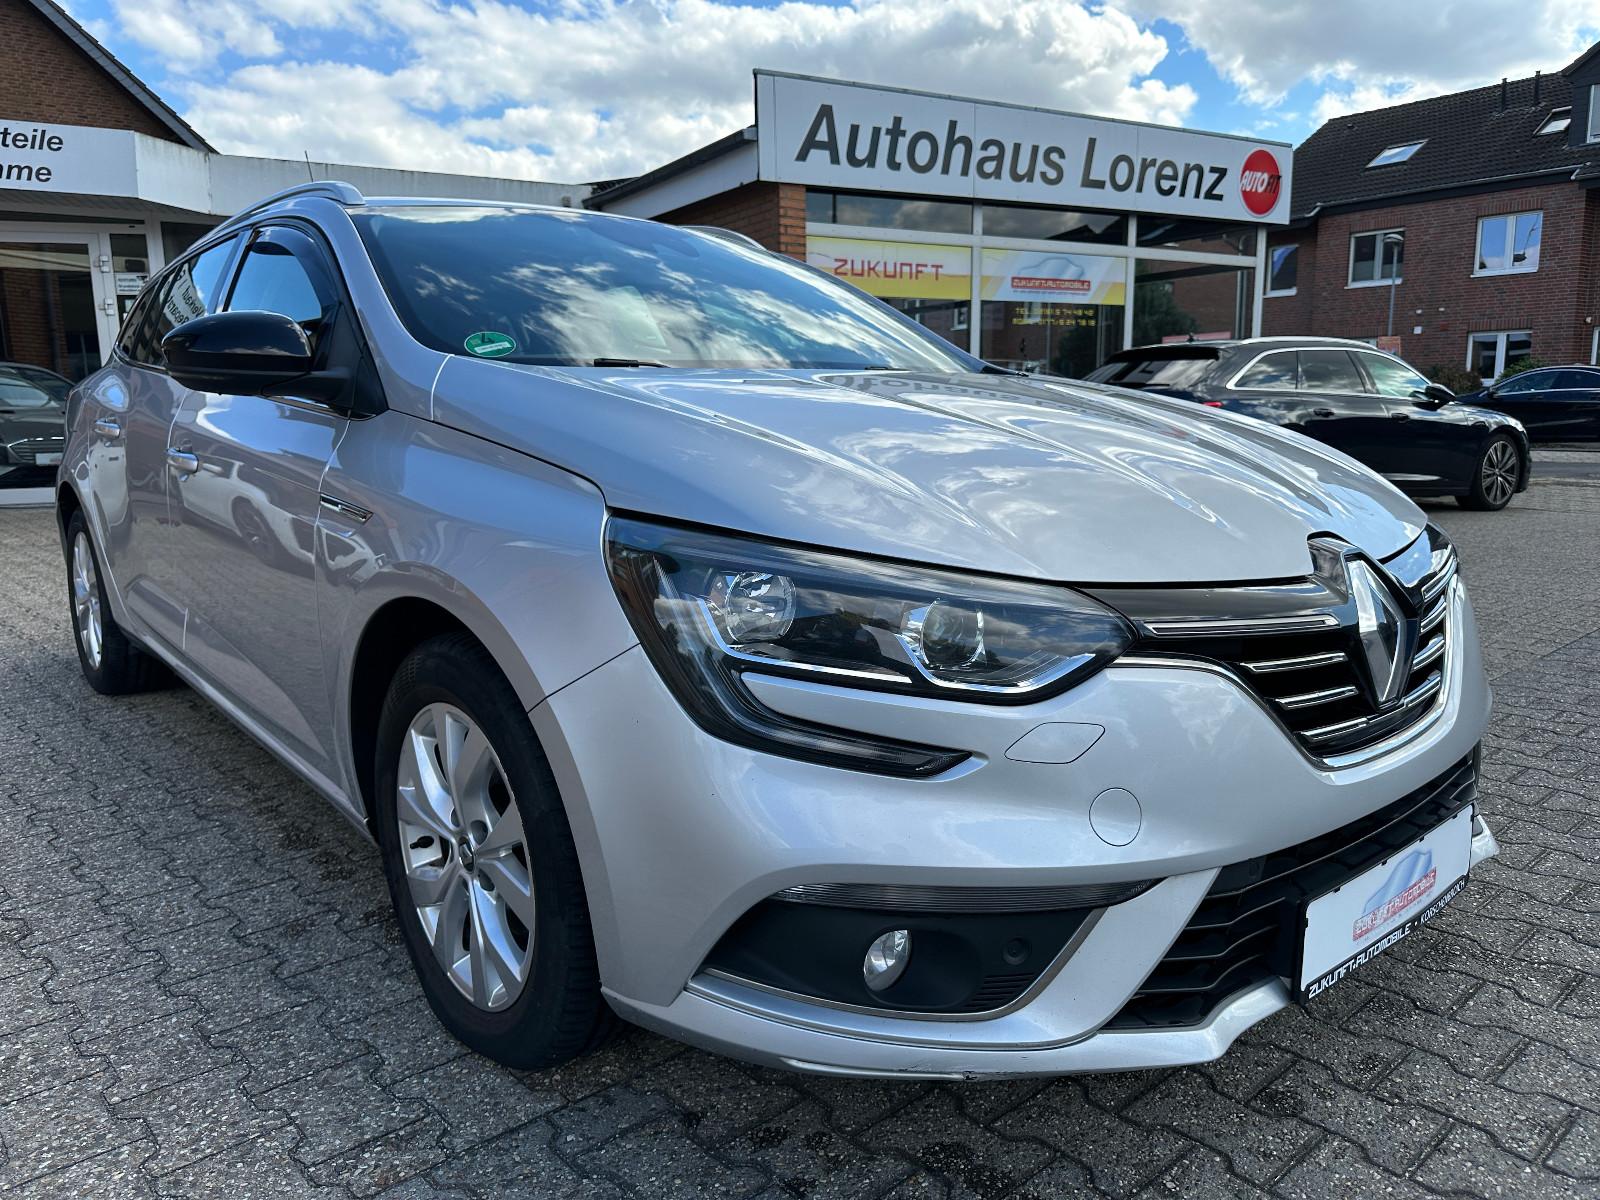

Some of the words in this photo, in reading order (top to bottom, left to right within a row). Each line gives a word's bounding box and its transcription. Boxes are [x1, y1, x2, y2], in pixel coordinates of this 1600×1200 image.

[794, 103, 1066, 187] Autohaus
[1079, 136, 1228, 201] Lorenz
[833, 258, 944, 281] ZUKUNFT
[1308, 922, 1412, 1000] ZUKUNFT.AUTOMOBILE
